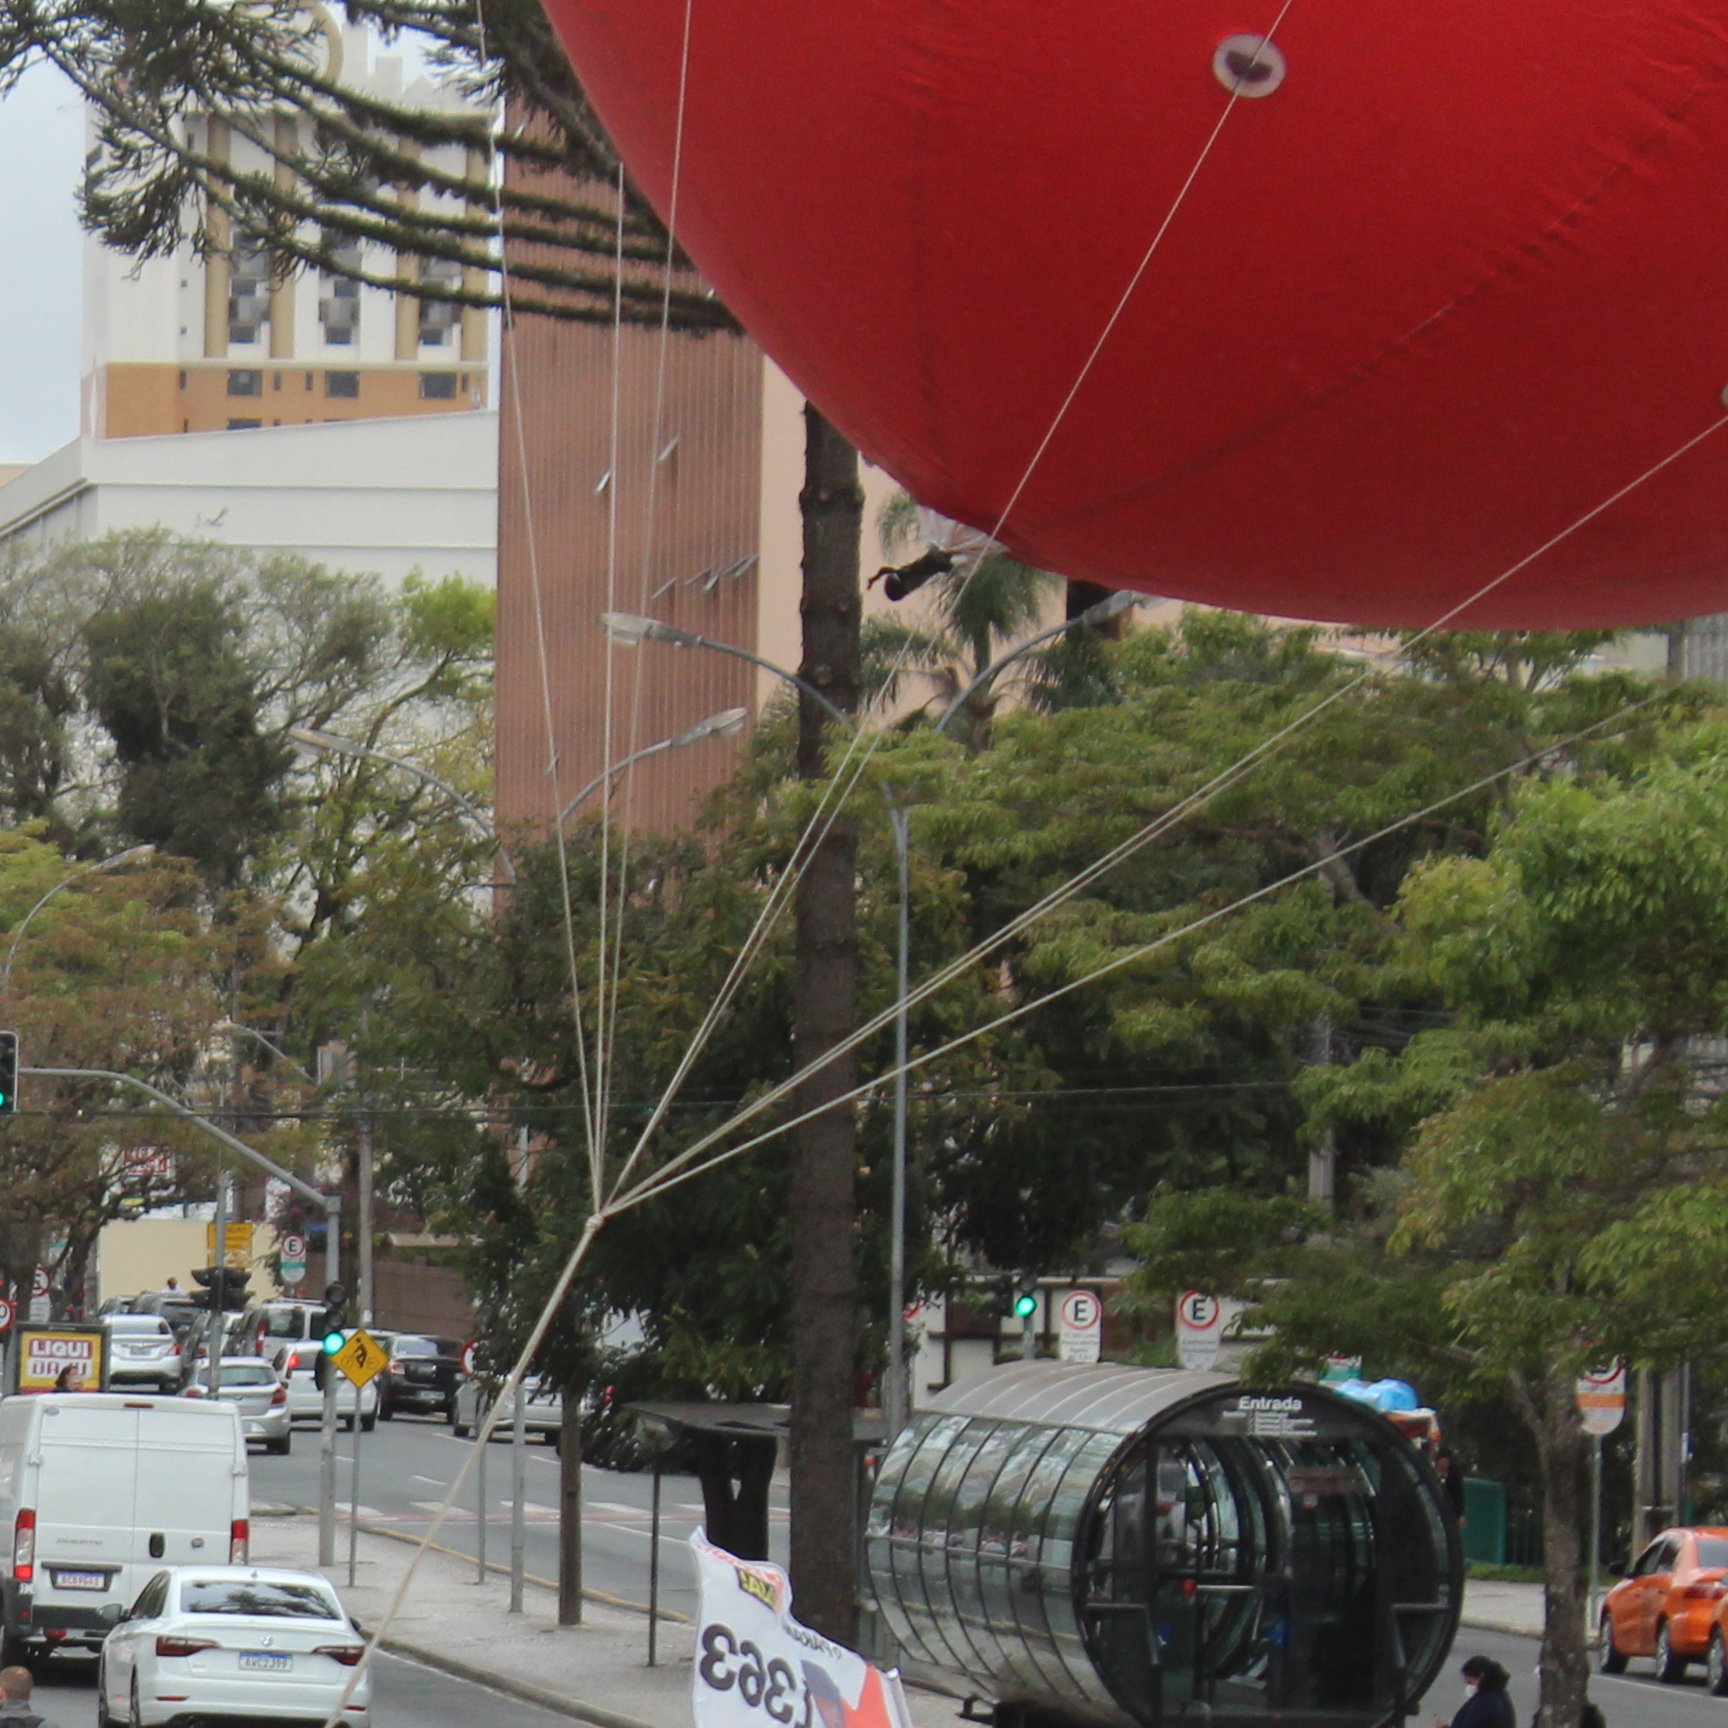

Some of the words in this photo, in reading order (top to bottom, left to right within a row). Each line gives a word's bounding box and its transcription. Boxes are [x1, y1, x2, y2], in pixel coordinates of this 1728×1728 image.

[288, 1240, 297, 1252] E
[1074, 1300, 1088, 1321] E
[1192, 1299, 1206, 1321] E
[29, 1341, 89, 1358] LIQUI
[1239, 1396, 1303, 1412] Entrada
